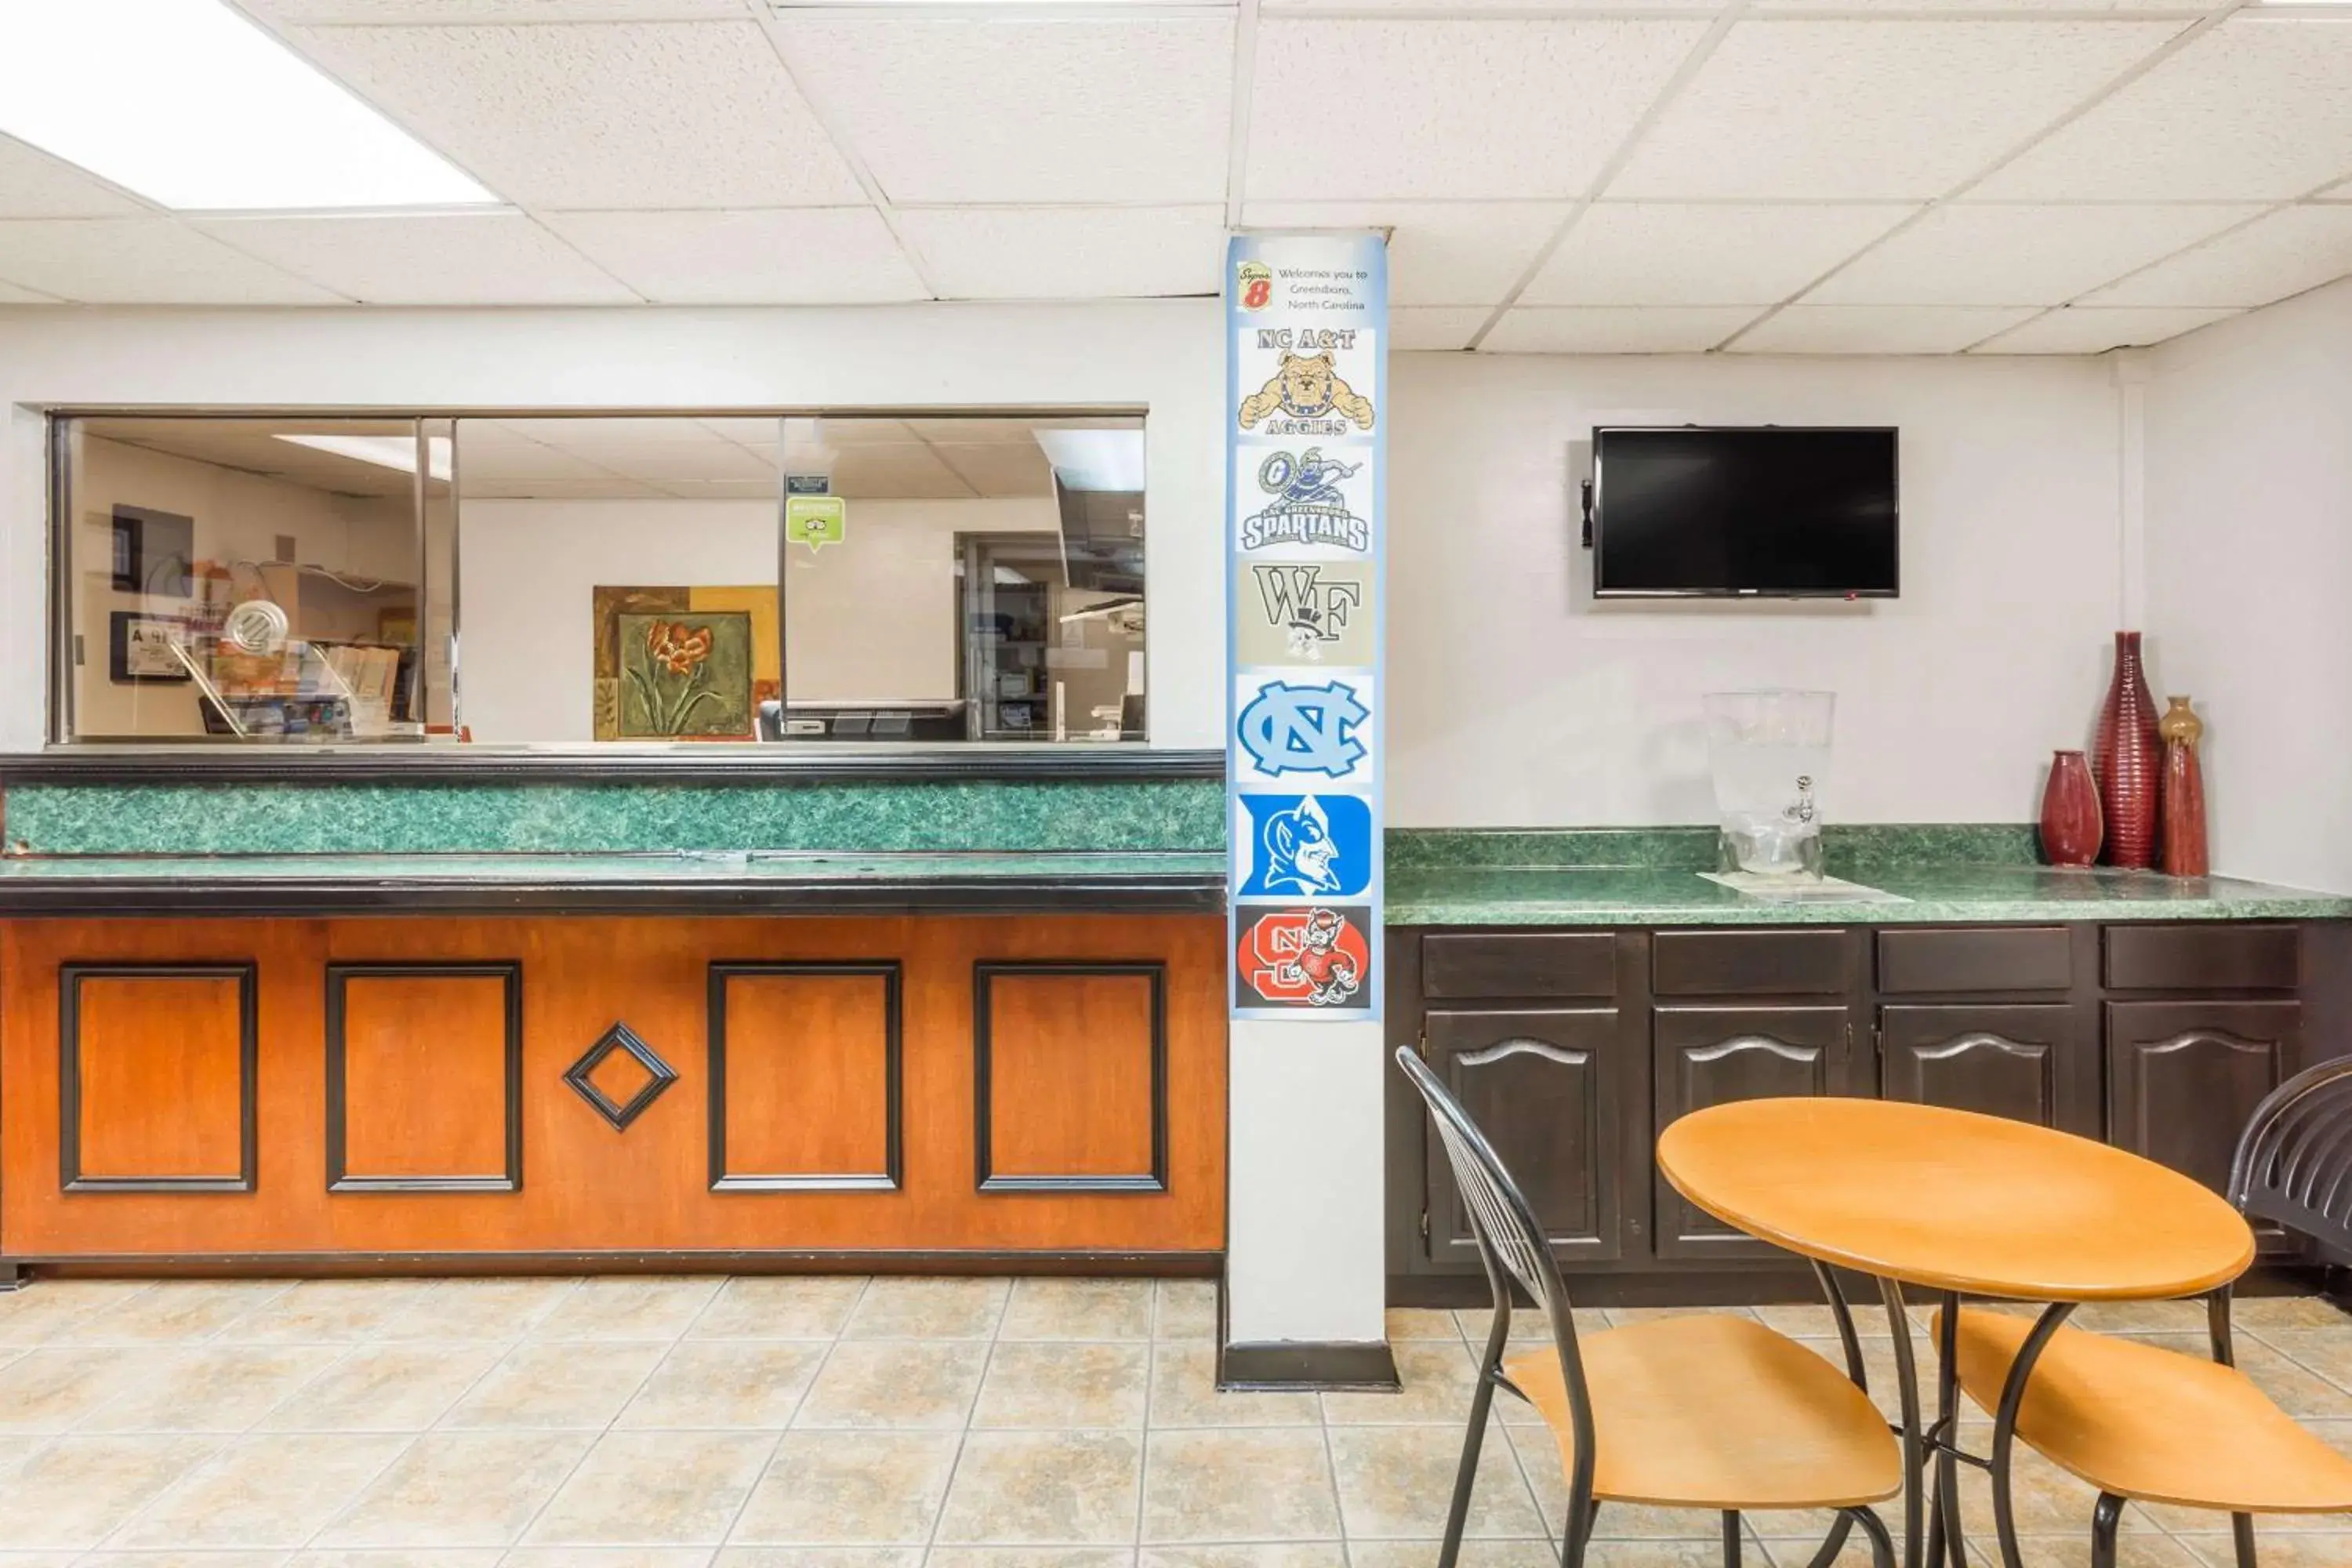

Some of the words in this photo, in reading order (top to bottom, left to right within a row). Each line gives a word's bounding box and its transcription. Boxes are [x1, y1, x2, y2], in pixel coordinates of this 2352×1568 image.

[1279, 268, 1330, 279] Welcomes
[1334, 270, 1352, 281] you
[1356, 270, 1368, 279] to
[1244, 279, 1270, 308] 8
[1288, 299, 1319, 310] North
[1321, 299, 1365, 310] Carolina
[1257, 328, 1293, 349] NC
[1297, 328, 1356, 350] A&T
[1265, 419, 1347, 435] AGGIES
[1241, 513, 1370, 552] SPARTANS
